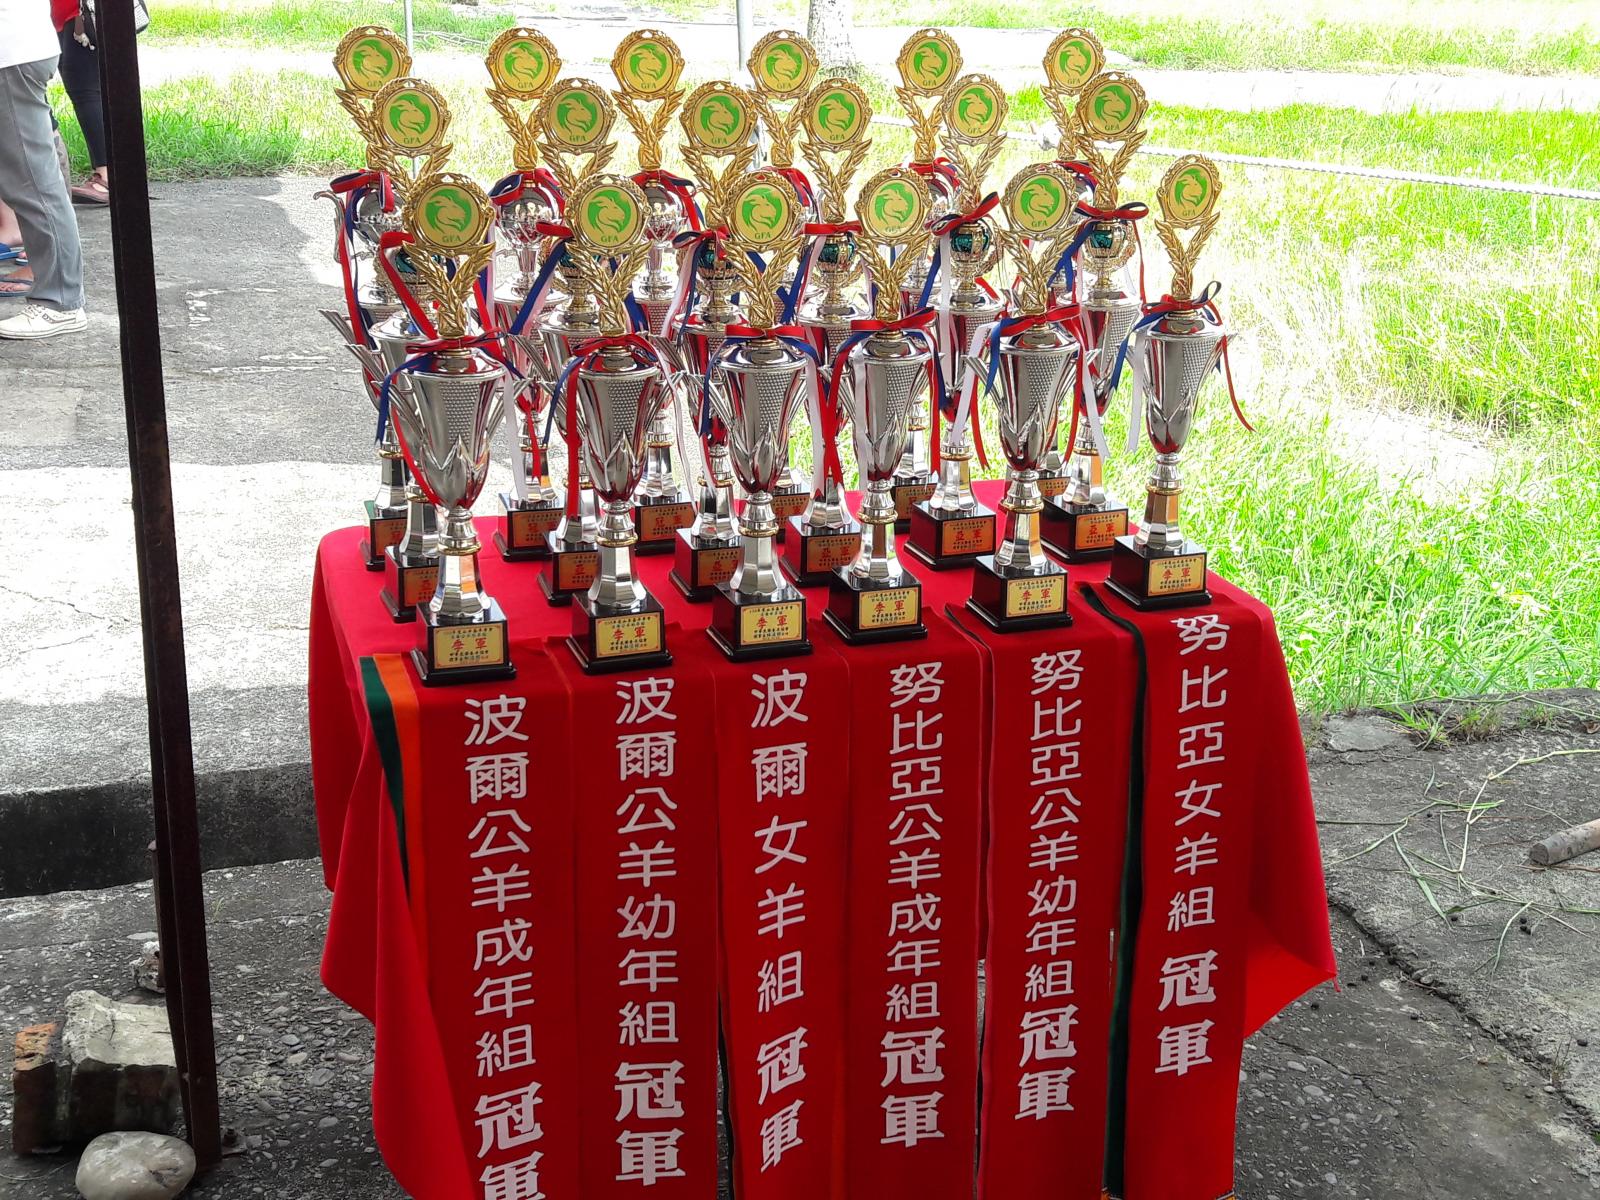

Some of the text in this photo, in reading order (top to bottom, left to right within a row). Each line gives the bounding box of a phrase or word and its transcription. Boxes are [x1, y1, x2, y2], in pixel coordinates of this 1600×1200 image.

[517, 80, 534, 89] GFA
[640, 82, 657, 90] GFA
[776, 81, 793, 90] GFA
[922, 79, 938, 87] GFA
[1104, 123, 1121, 132] GFA
[403, 137, 421, 145] GFA
[569, 134, 587, 143] GFA
[710, 136, 728, 145] GFA
[829, 133, 846, 141] GFA
[1181, 209, 1196, 217] GFA
[1031, 219, 1048, 228] GFA
[441, 235, 462, 243] GFA
[600, 234, 619, 243] GFA
[754, 231, 771, 240] GFA
[1088, 522, 1115, 535] 亞軍
[954, 528, 982, 542] 亞軍
[1162, 567, 1191, 581] 季軍
[1022, 587, 1051, 602] 季軍
[874, 599, 904, 614] 季軍
[756, 614, 787, 629] 季軍
[611, 625, 644, 641] 季軍
[451, 636, 487, 652] 季軍
